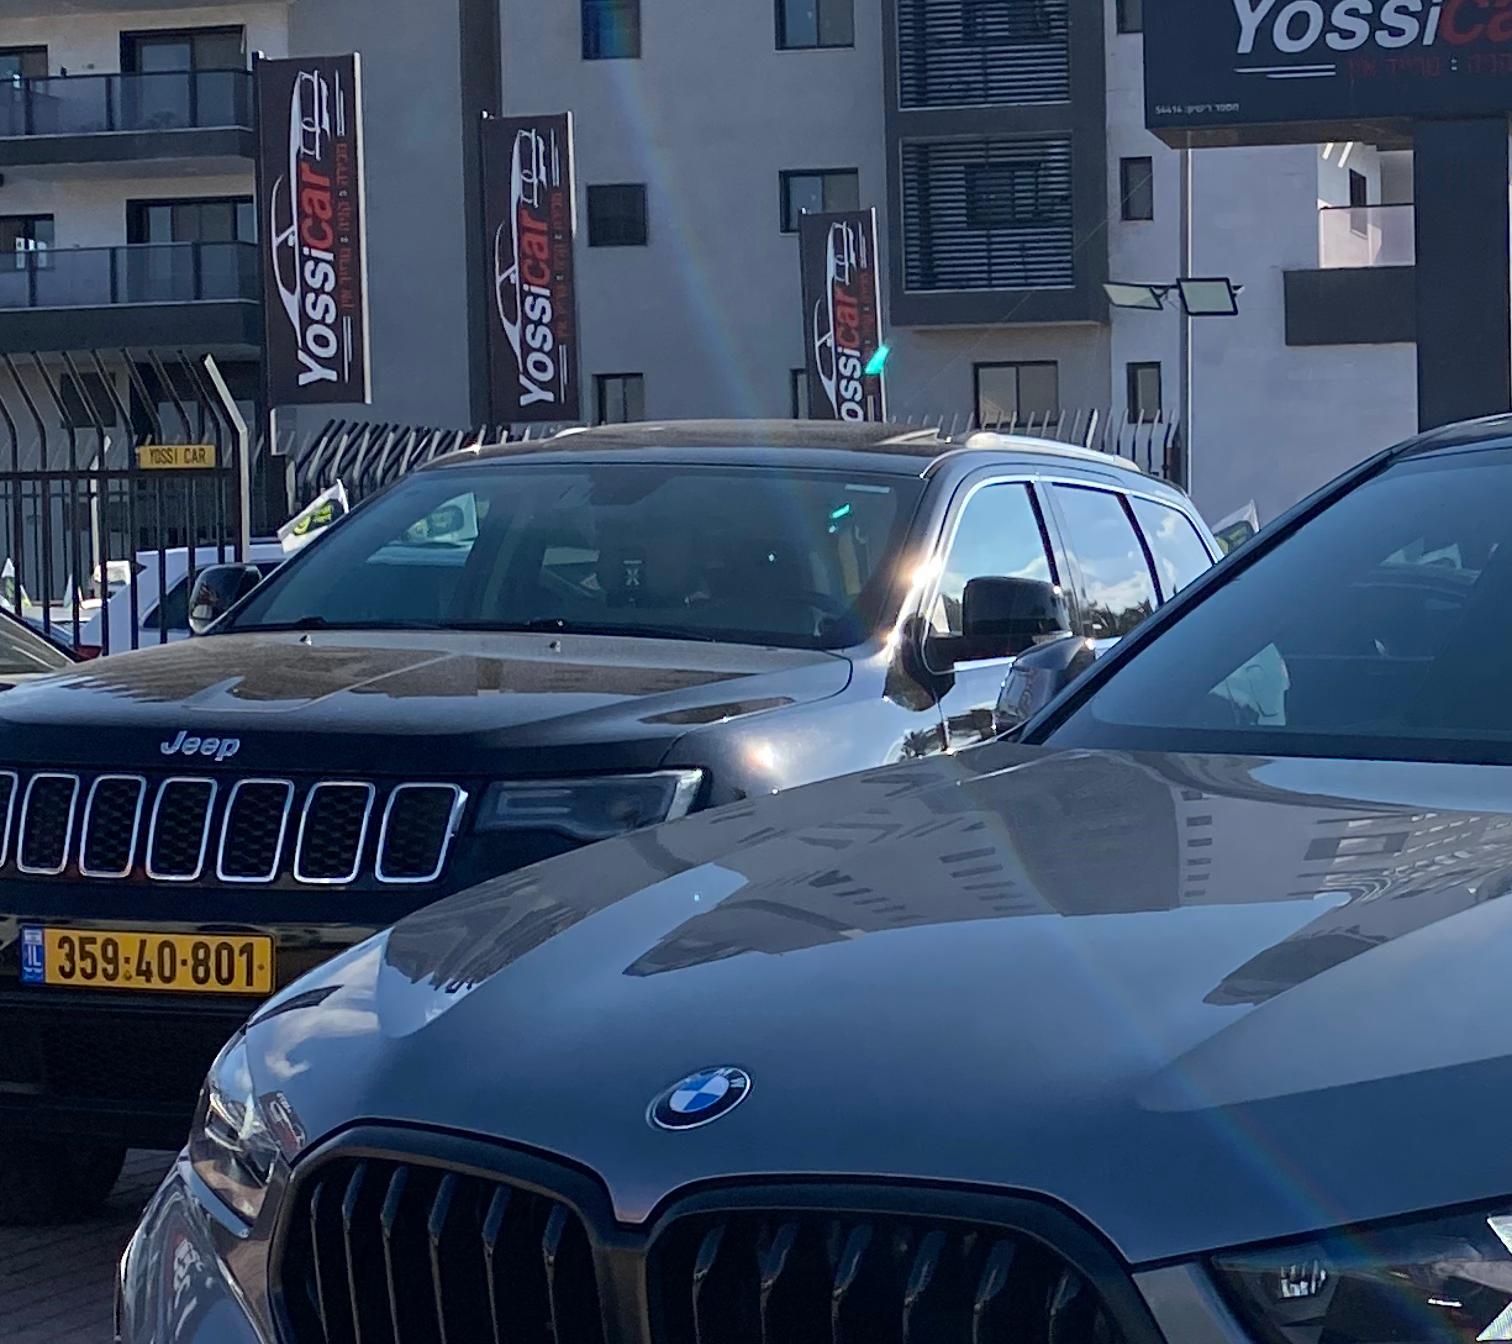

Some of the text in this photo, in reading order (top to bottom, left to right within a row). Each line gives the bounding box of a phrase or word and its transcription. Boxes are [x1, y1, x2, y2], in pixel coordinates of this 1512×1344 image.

[834, 284, 865, 422] ossicar
[149, 447, 207, 464] YOSSI CAR
[160, 730, 240, 762] Jeep
